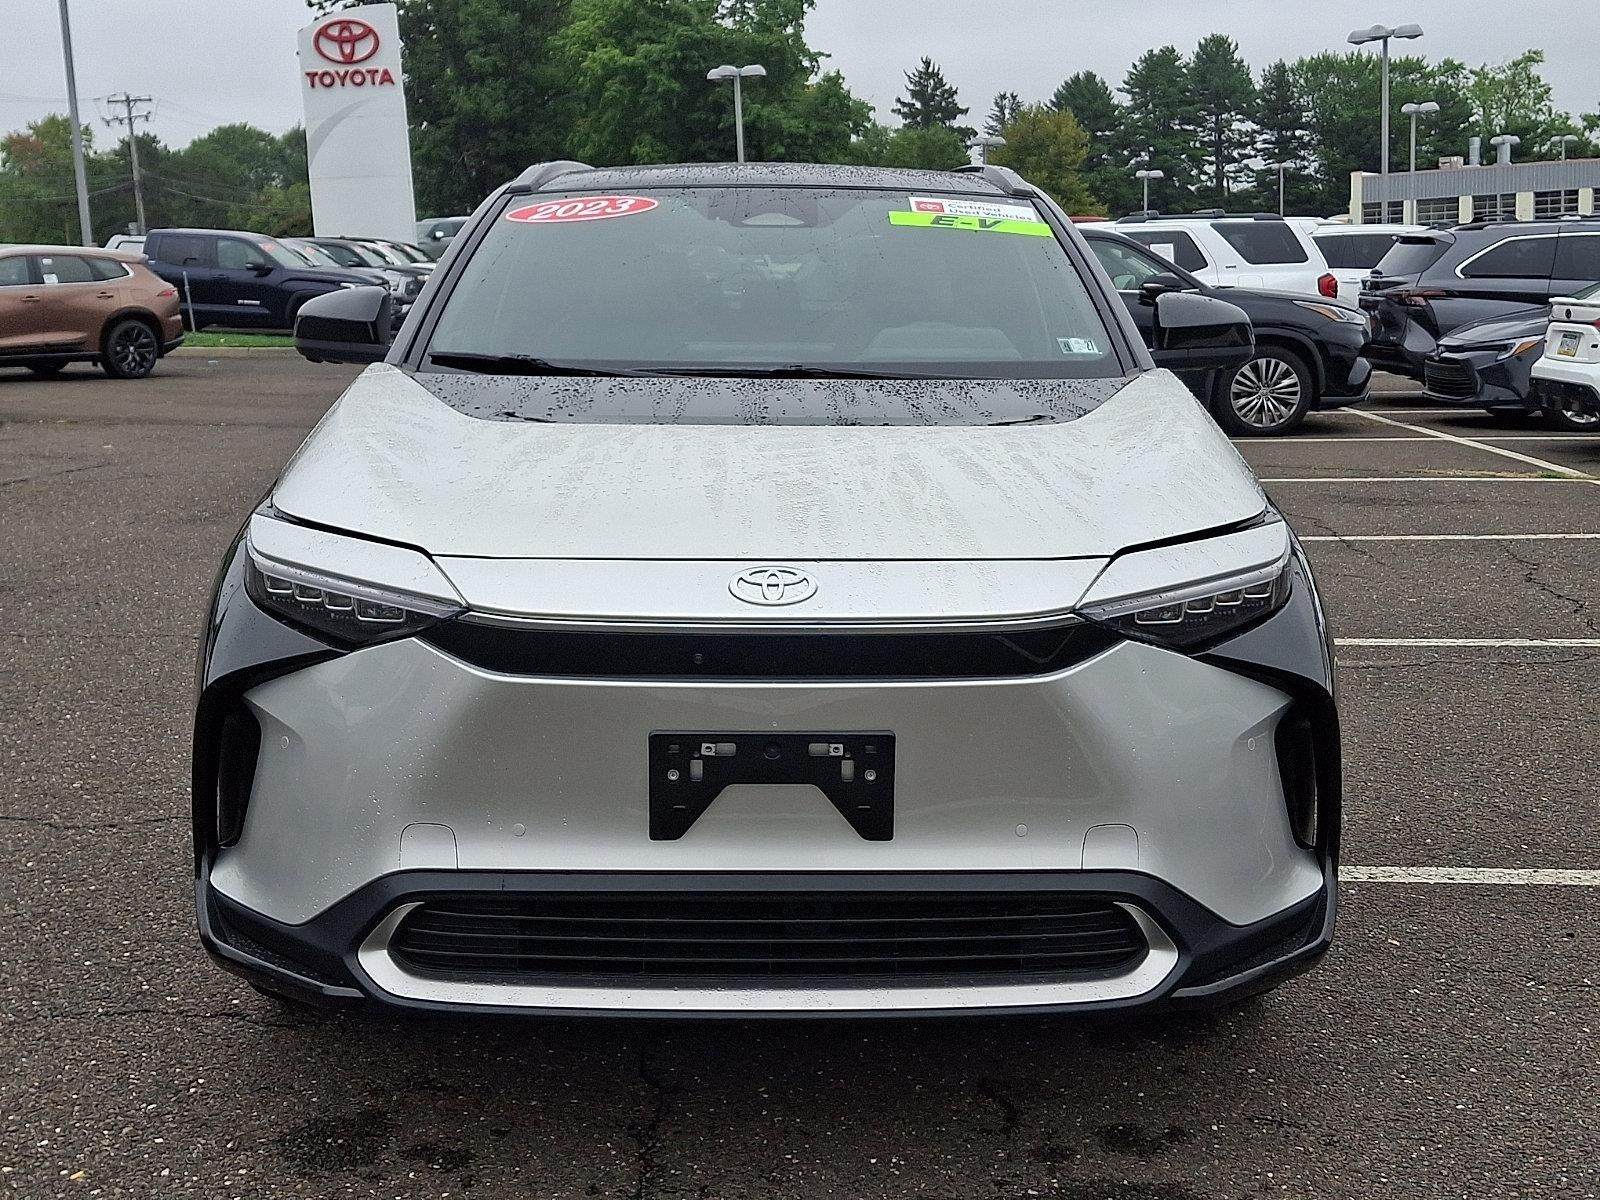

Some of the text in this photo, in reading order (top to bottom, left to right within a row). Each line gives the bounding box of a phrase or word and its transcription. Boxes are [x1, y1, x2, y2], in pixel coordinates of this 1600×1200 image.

[305, 68, 395, 88] TOYOTA
[527, 198, 637, 220] 2023
[948, 203, 1001, 213] Certified
[929, 215, 1003, 229] E-V
[983, 211, 1032, 221] Vehicles
